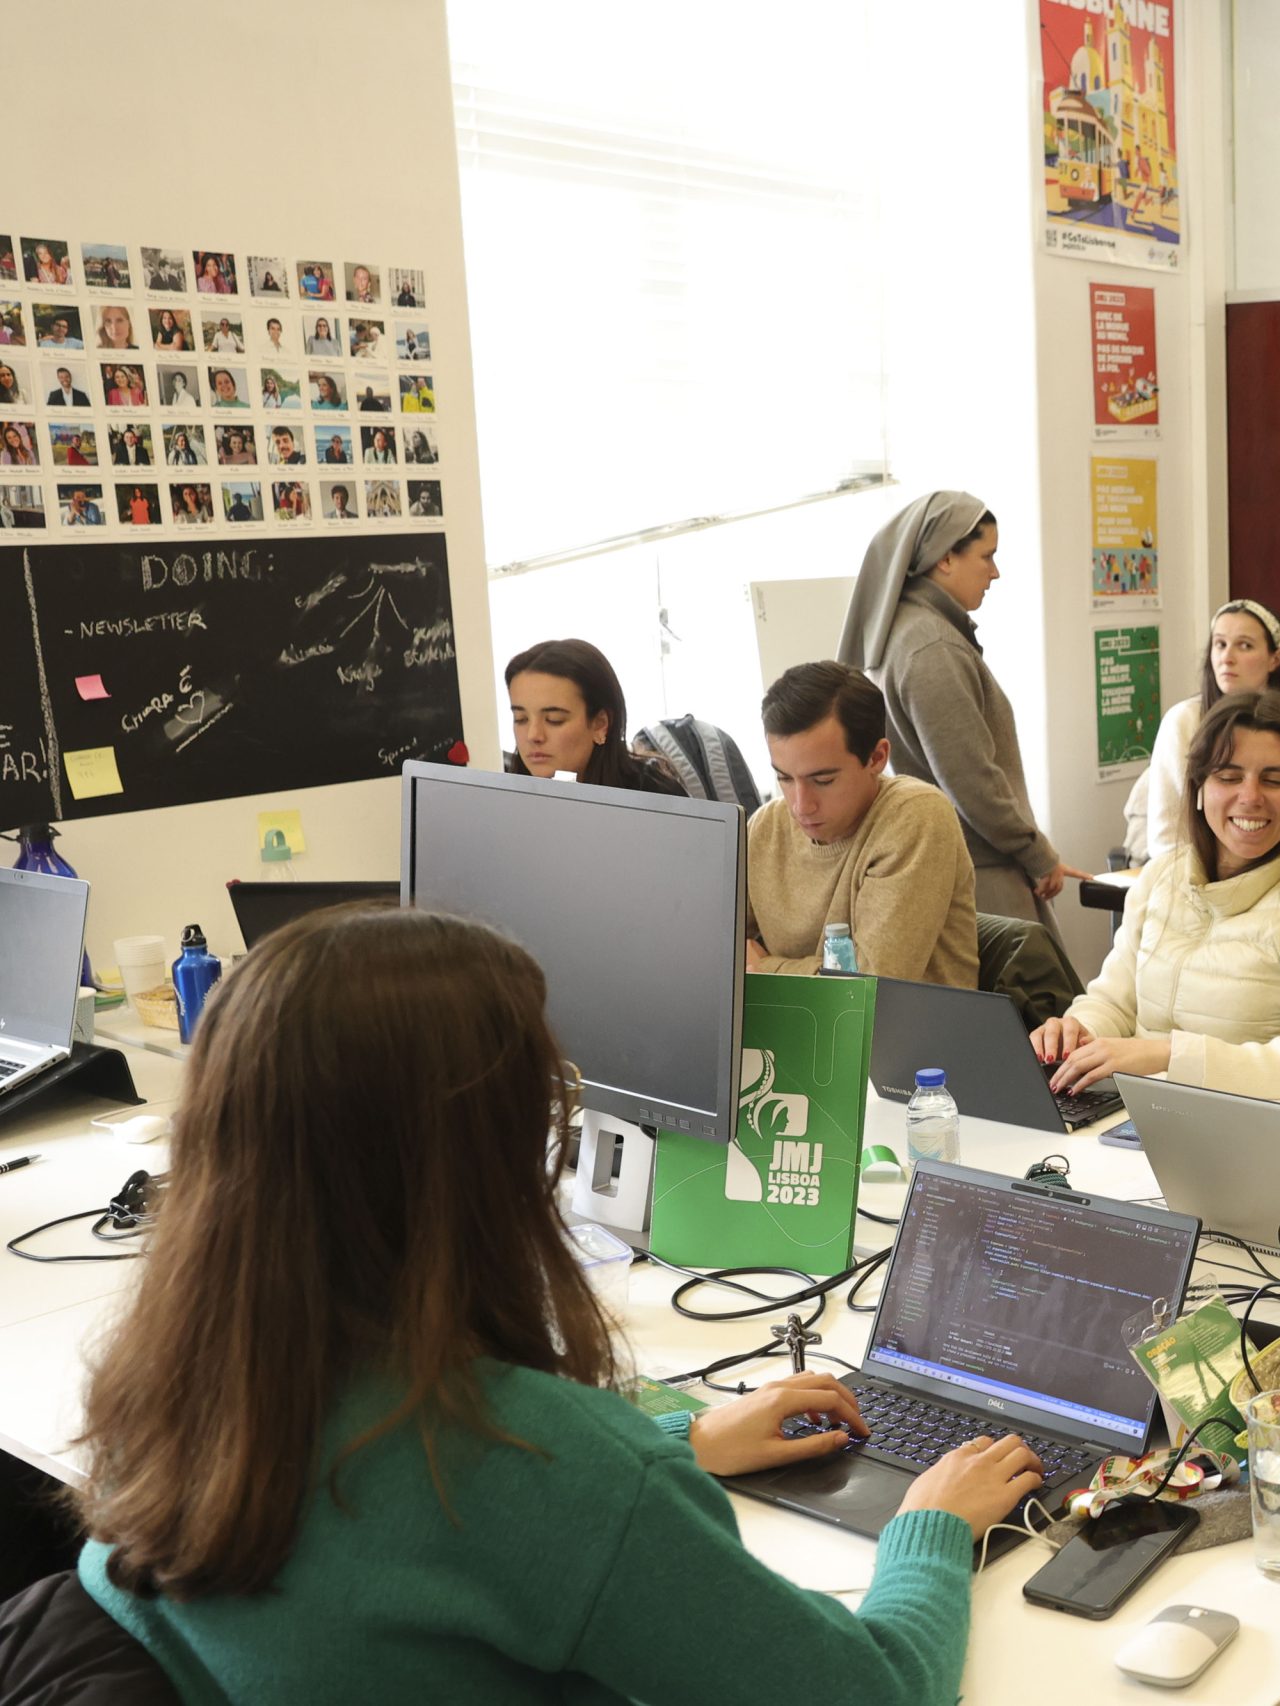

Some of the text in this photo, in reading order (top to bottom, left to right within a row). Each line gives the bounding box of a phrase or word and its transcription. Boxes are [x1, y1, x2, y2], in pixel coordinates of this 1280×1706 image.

[80, 608, 207, 639] NEWSLETTER
[882, 1086, 913, 1096] TOSHIBA
[769, 1140, 823, 1174] JMJ
[768, 1172, 820, 1187] LISBOA
[767, 1185, 819, 1206] 2023
[987, 1399, 1005, 1410] DELL
